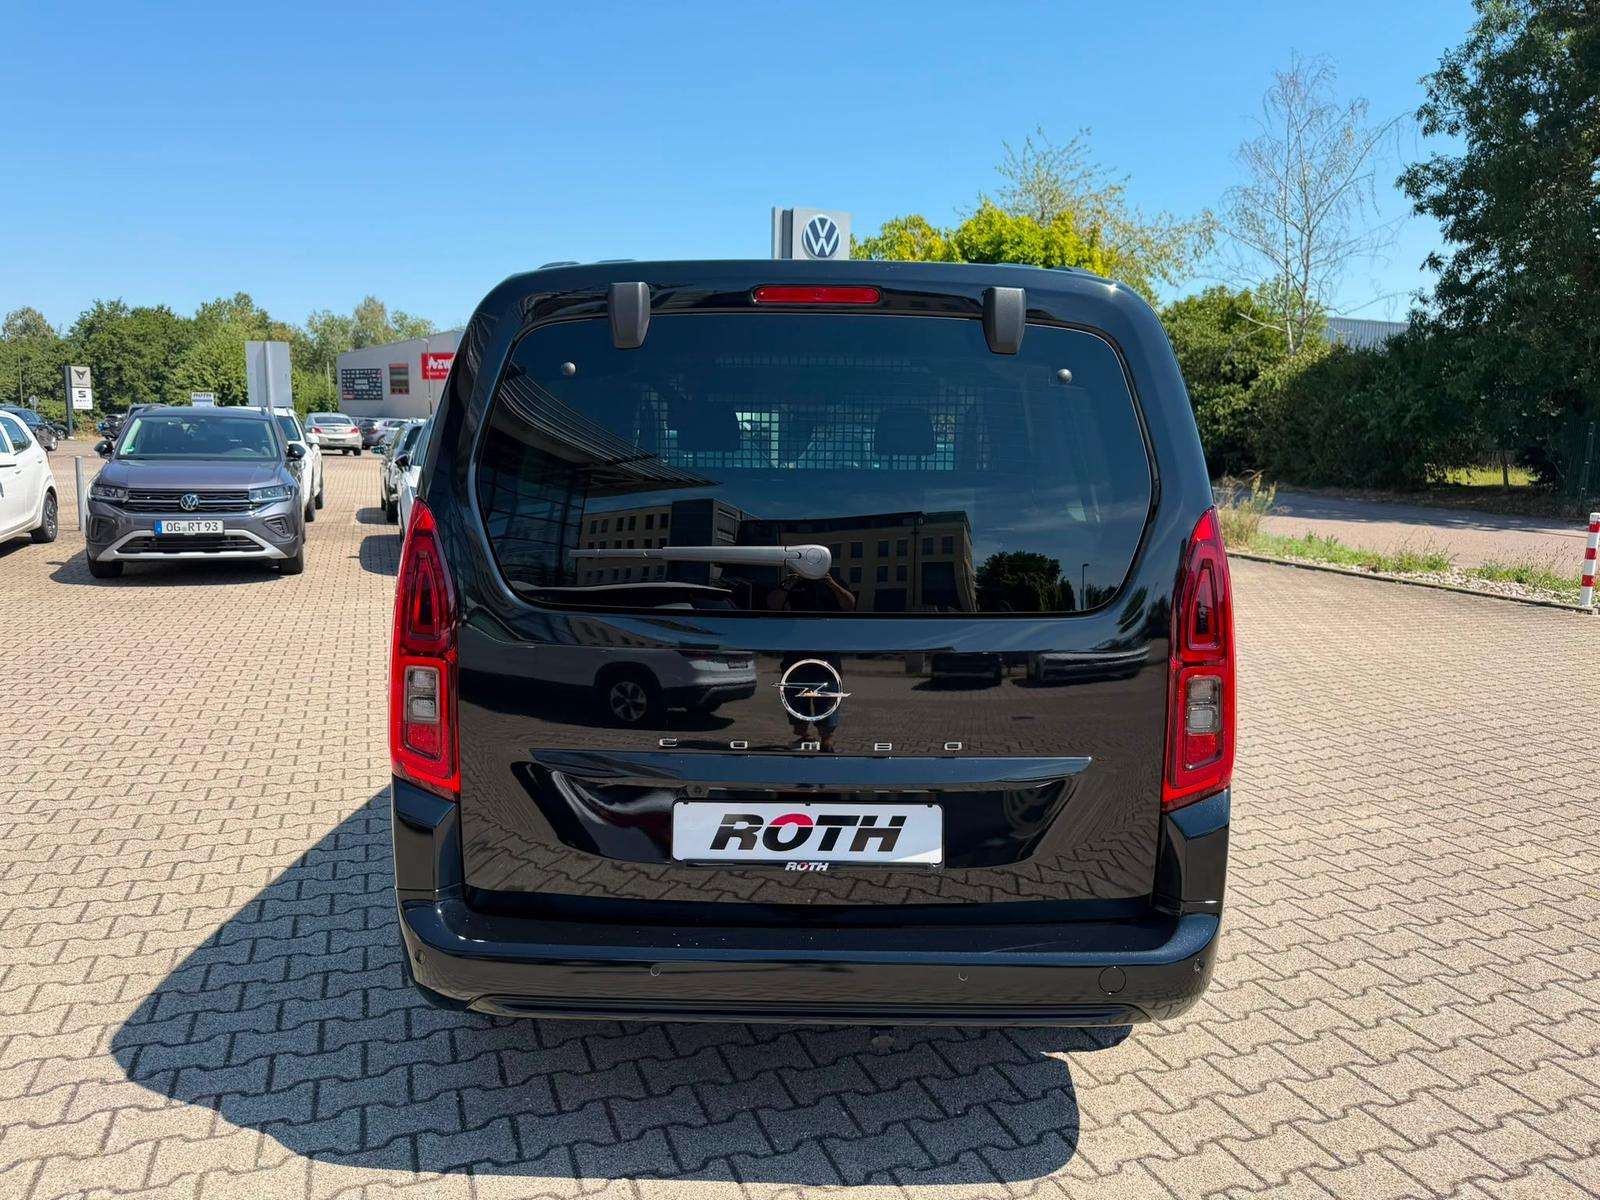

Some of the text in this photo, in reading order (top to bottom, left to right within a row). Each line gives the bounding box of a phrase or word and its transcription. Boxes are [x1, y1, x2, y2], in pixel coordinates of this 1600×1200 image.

[166, 522, 181, 532] OG
[659, 738, 962, 751] COMBO
[709, 813, 907, 852] ROTH
[785, 861, 829, 871] ROTH
